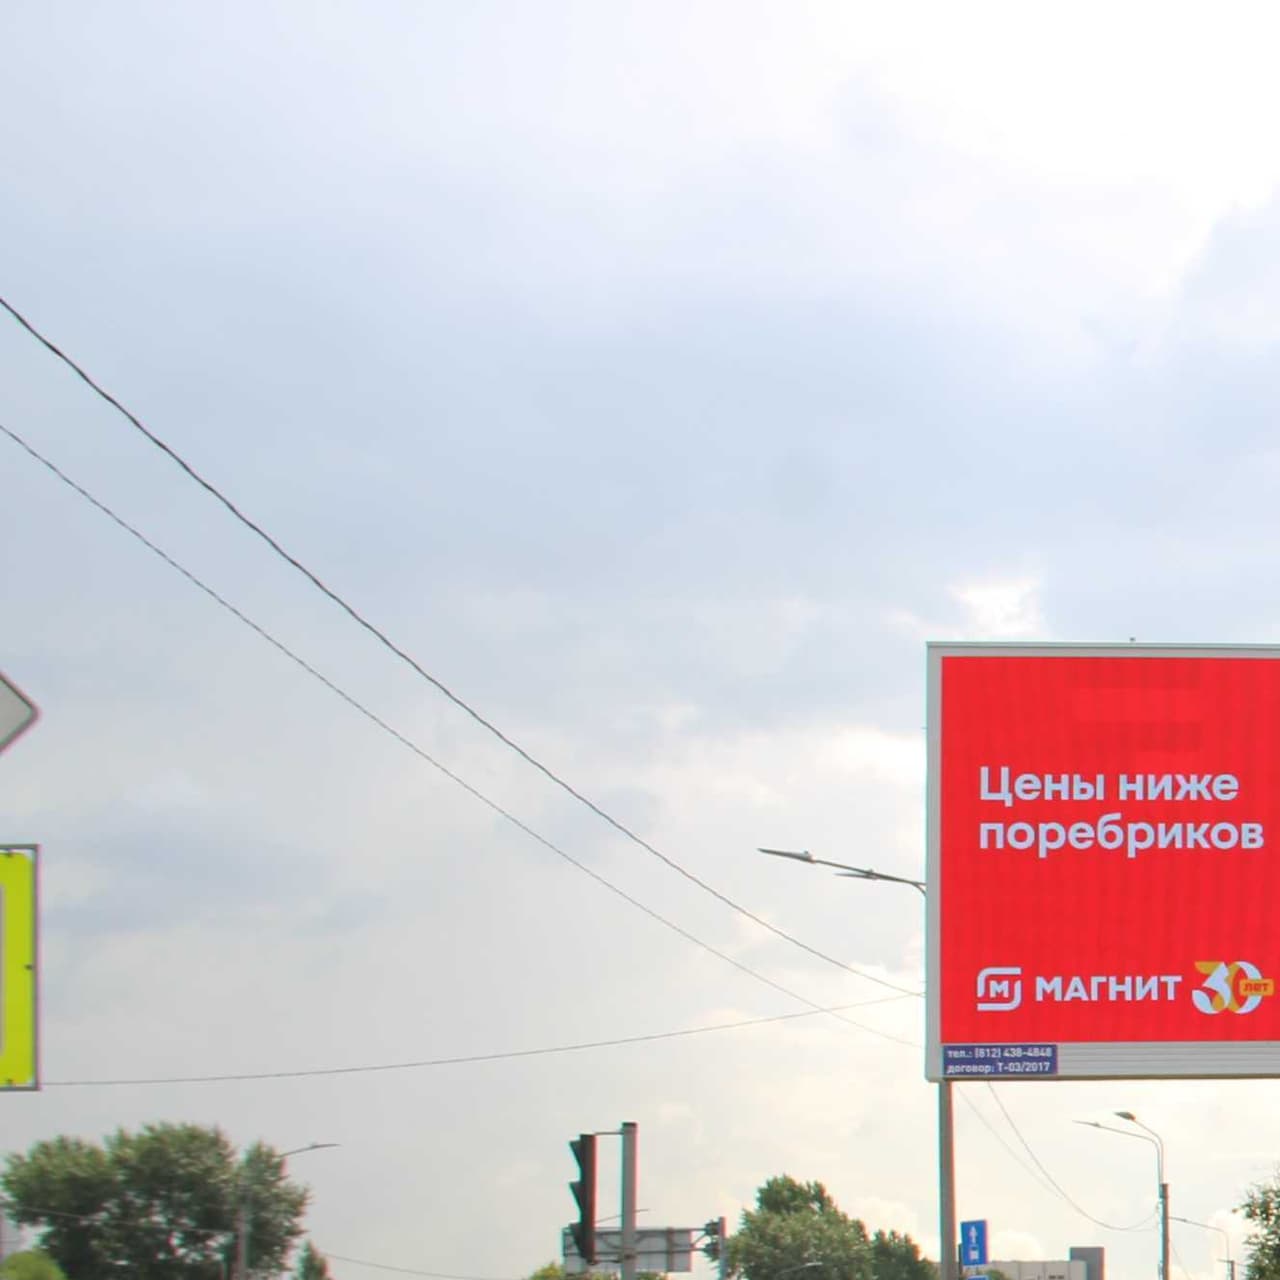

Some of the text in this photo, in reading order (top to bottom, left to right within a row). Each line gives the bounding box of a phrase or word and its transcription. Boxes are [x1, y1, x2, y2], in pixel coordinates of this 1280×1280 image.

[980, 766, 1239, 807] Цены ниже
[980, 812, 1264, 858] поребриков
[1036, 961, 1263, 1014] МАГНИТ 30
[1243, 982, 1269, 993] лет
[947, 1062, 1050, 1074] договор: Т-03/2017
